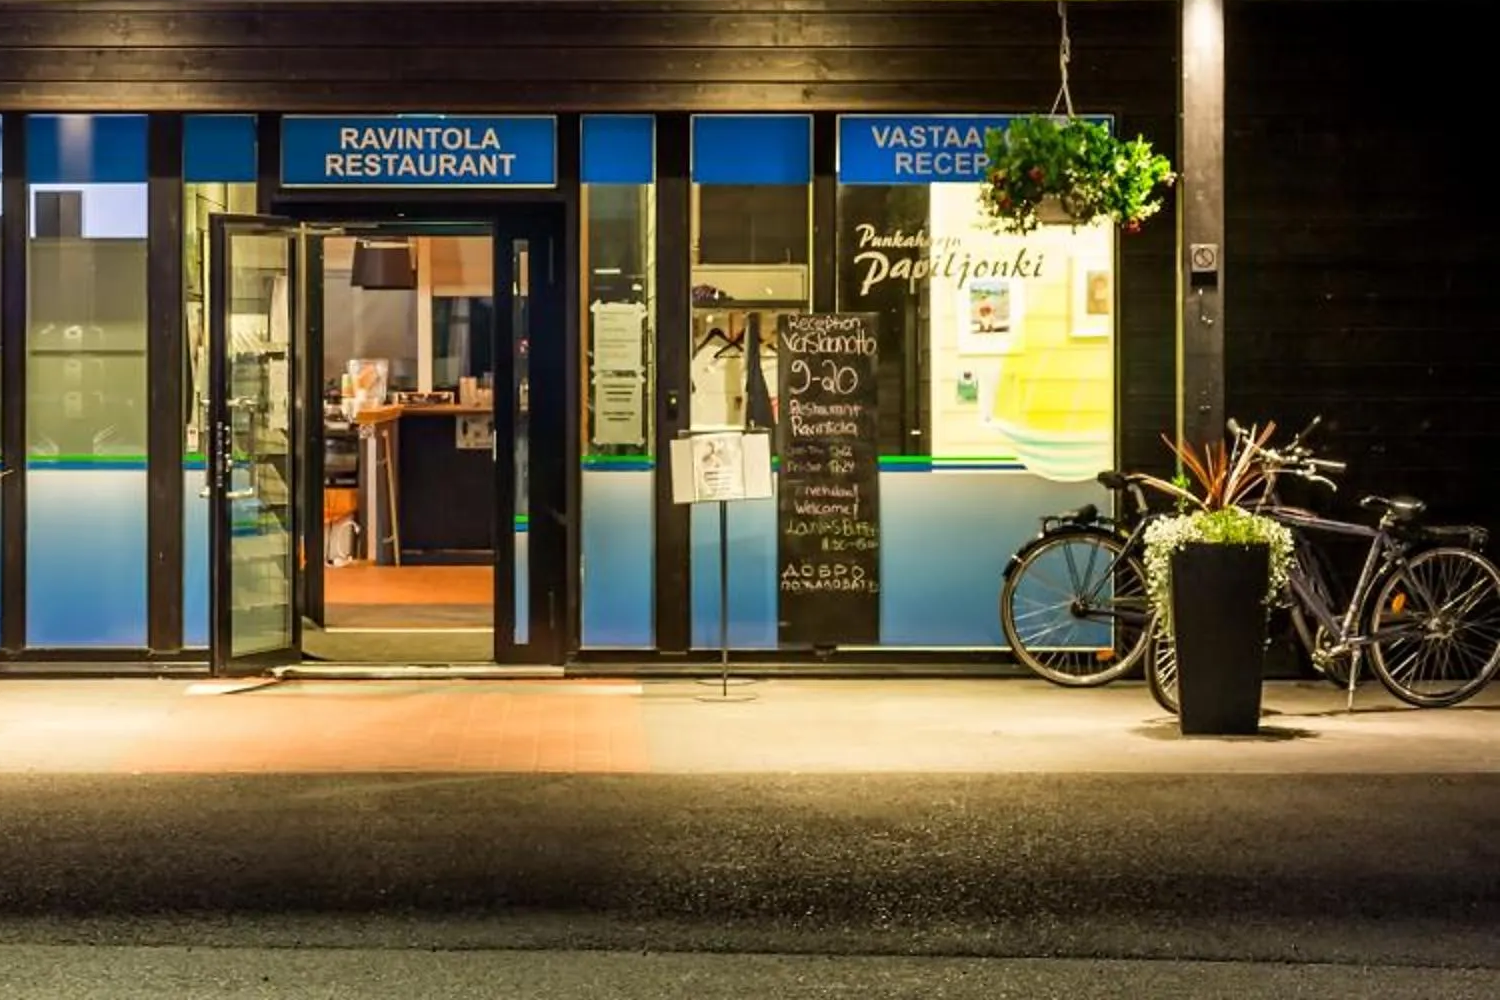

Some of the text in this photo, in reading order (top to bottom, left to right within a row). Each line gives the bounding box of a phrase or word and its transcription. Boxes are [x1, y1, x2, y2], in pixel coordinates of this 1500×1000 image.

[340, 127, 500, 150] RAVINTOLA
[871, 126, 1012, 148] VASTAA
[325, 153, 516, 176] RESTAURANT
[894, 152, 991, 175] RECEP
[853, 248, 1044, 297] Paviljonki
[788, 359, 859, 394] 9-20
